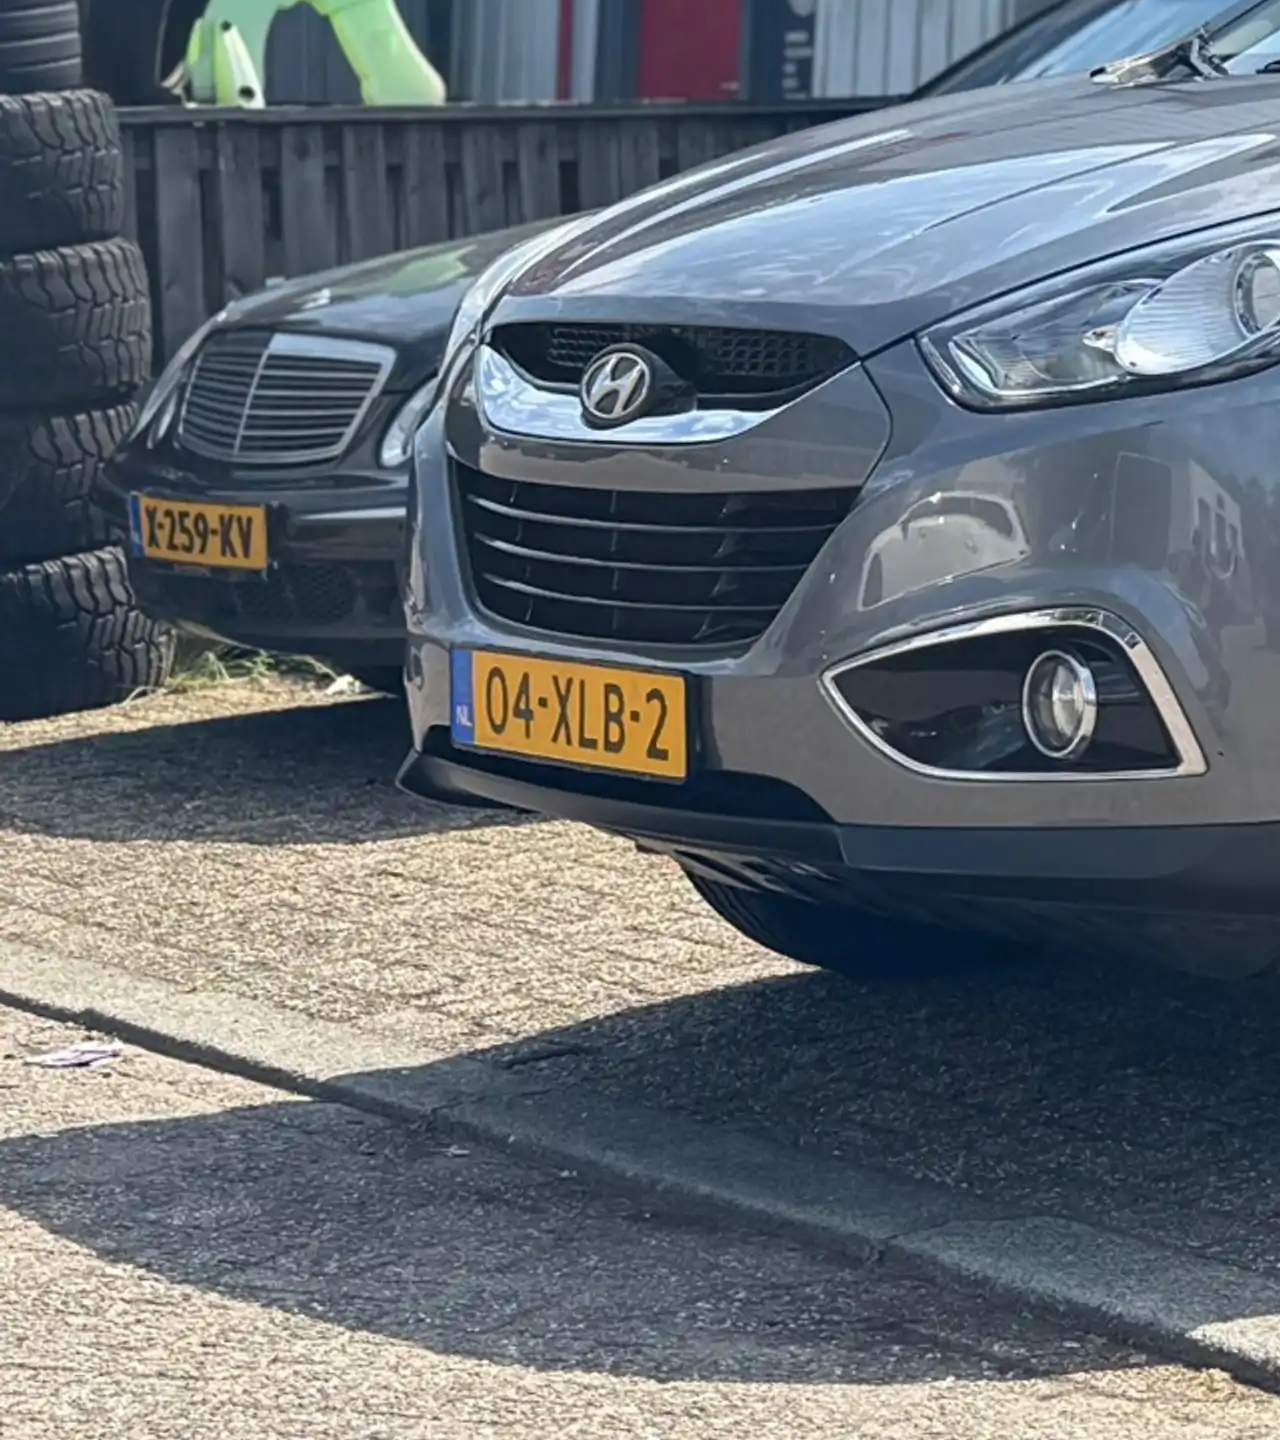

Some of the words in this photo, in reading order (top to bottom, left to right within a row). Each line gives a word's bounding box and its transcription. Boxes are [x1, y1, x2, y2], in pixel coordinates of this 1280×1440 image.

[144, 504, 254, 559] X-259-KV
[456, 705, 472, 727] NL
[485, 665, 669, 762] 04-XLB-2
